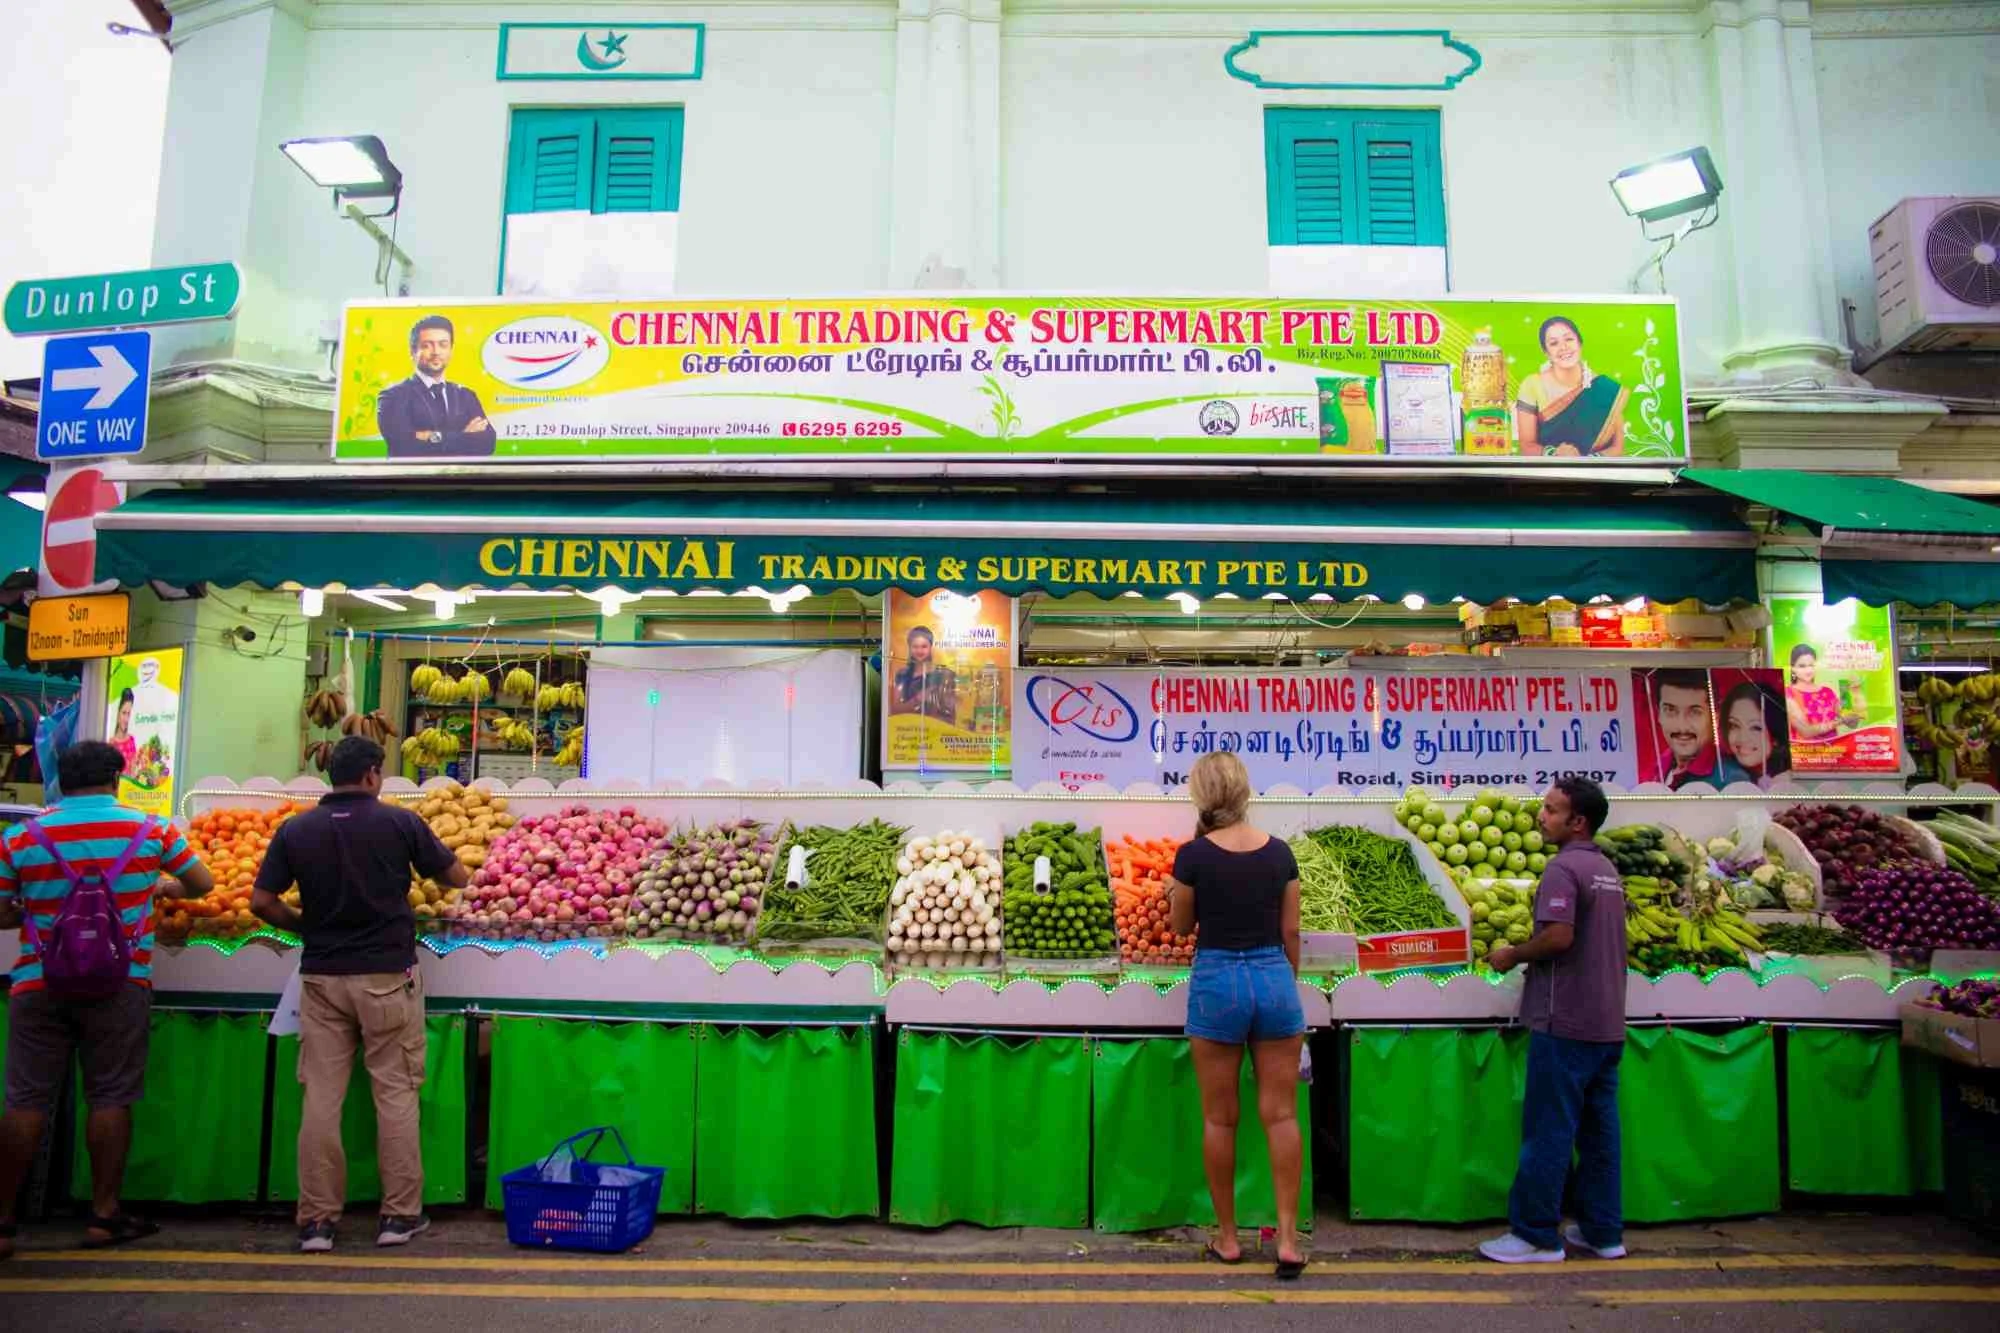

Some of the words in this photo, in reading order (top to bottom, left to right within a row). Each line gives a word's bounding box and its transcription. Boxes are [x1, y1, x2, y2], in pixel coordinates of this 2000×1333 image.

[26, 281, 159, 318] Dunlop
[179, 272, 216, 304] St
[495, 331, 577, 345] CHENNAI
[610, 311, 780, 345] CHENNAI
[794, 310, 970, 344] TRADING
[984, 310, 1016, 344] &
[1030, 310, 1268, 345] SUPERMART
[1281, 311, 1359, 345] PTE
[1365, 312, 1440, 346] LTD
[682, 349, 834, 374] சென்னை
[970, 350, 993, 372] &
[47, 420, 87, 447] ONE
[96, 417, 136, 442] WAY
[505, 424, 530, 437] 127,
[535, 424, 556, 436] 129
[560, 423, 606, 438] Dunlop
[610, 424, 652, 437] Street,
[656, 423, 720, 438] Singapore
[725, 423, 770, 435] 209446
[799, 422, 847, 436] 6295
[854, 422, 902, 436] 6295
[479, 537, 736, 580] CHENNAI
[758, 554, 927, 581] TRADING
[937, 556, 967, 581] &
[989, 556, 1207, 586] SUPERMART
[1216, 559, 1288, 586] PTE
[1297, 560, 1369, 588] LTD
[68, 604, 89, 622] Sun
[30, 631, 62, 650] 12noon
[72, 626, 126, 651] 12midnight
[1151, 677, 1249, 714] CHENNAI
[1257, 676, 1355, 713] TRADING
[1364, 676, 1379, 713] &
[1387, 676, 1518, 713] SUPERMART
[1526, 676, 1573, 713] PTE.
[1382, 718, 1402, 750] &
[1060, 771, 1105, 781] Free
[1338, 771, 1402, 788] Road,
[1411, 771, 1527, 787] Singapore
[1535, 771, 1616, 785] 219797
